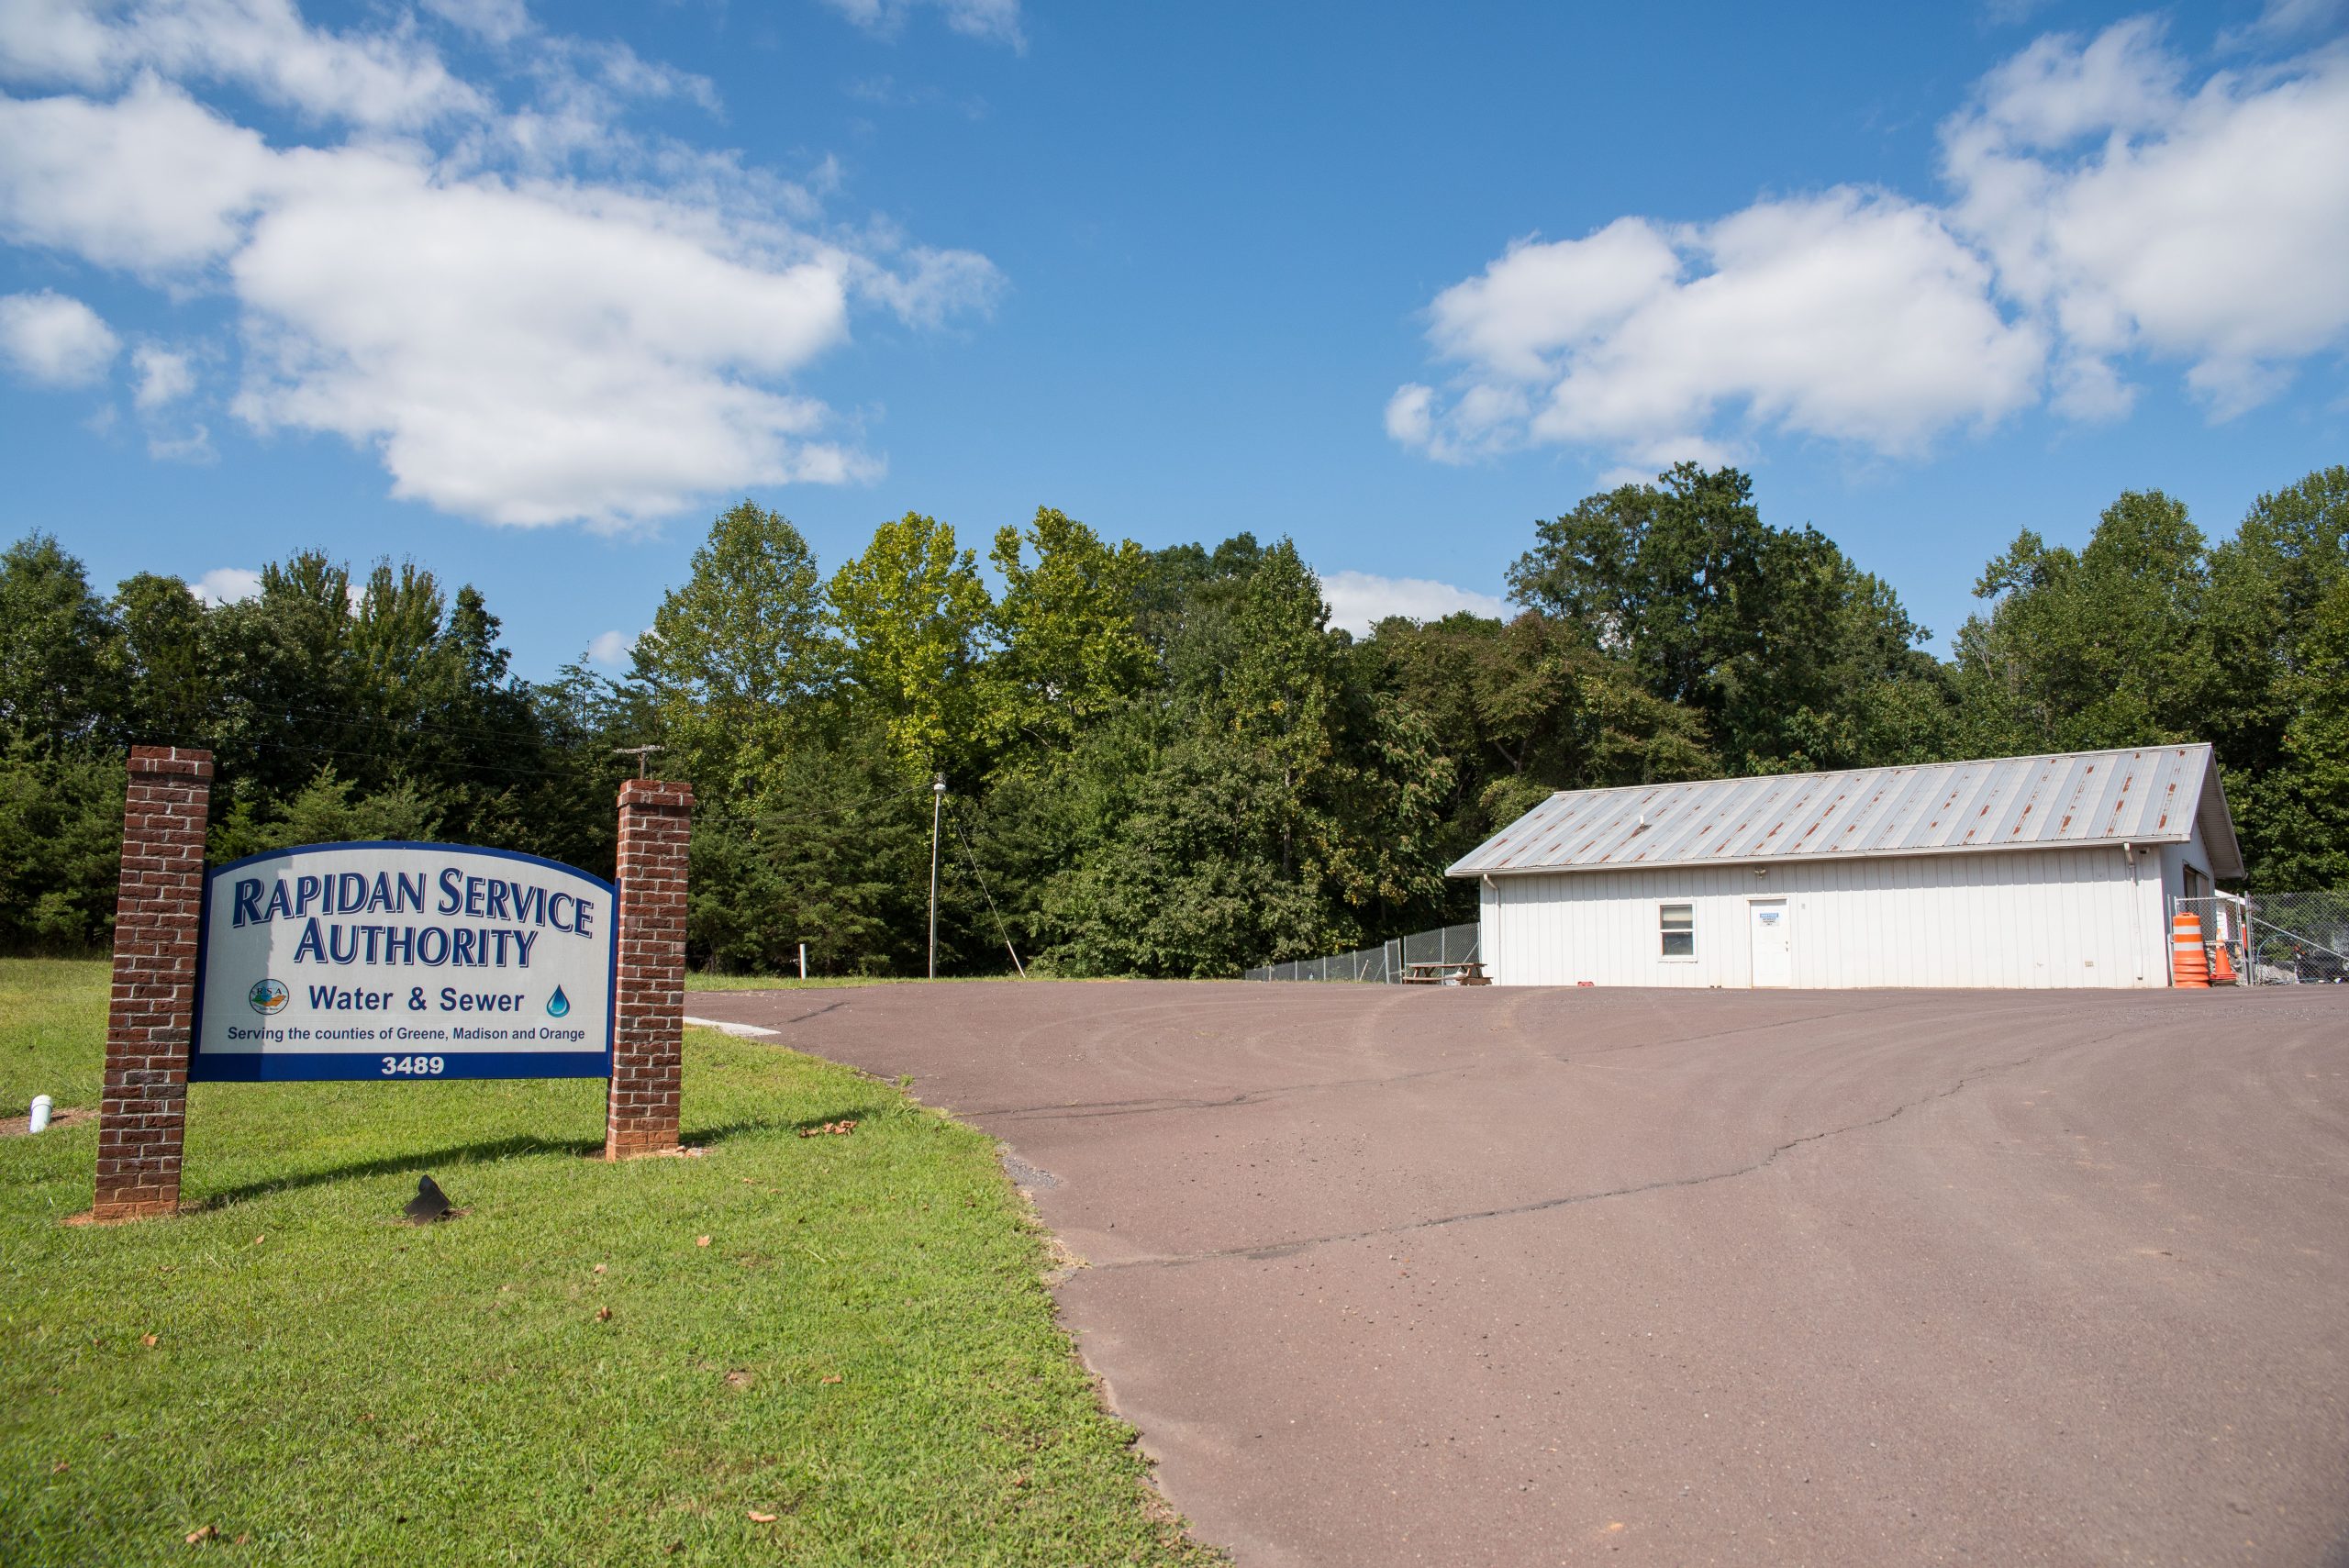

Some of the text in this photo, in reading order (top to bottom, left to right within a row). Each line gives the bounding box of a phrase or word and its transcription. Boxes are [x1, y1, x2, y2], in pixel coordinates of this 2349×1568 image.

[232, 867, 595, 939] RAPIDAN SERVICE
[294, 917, 539, 968] AUTHORITY
[308, 984, 525, 1012] Water & Sewer
[228, 1027, 585, 1042] Serving the counties of Greene, Madison and Orange
[381, 1056, 445, 1074] 3489
